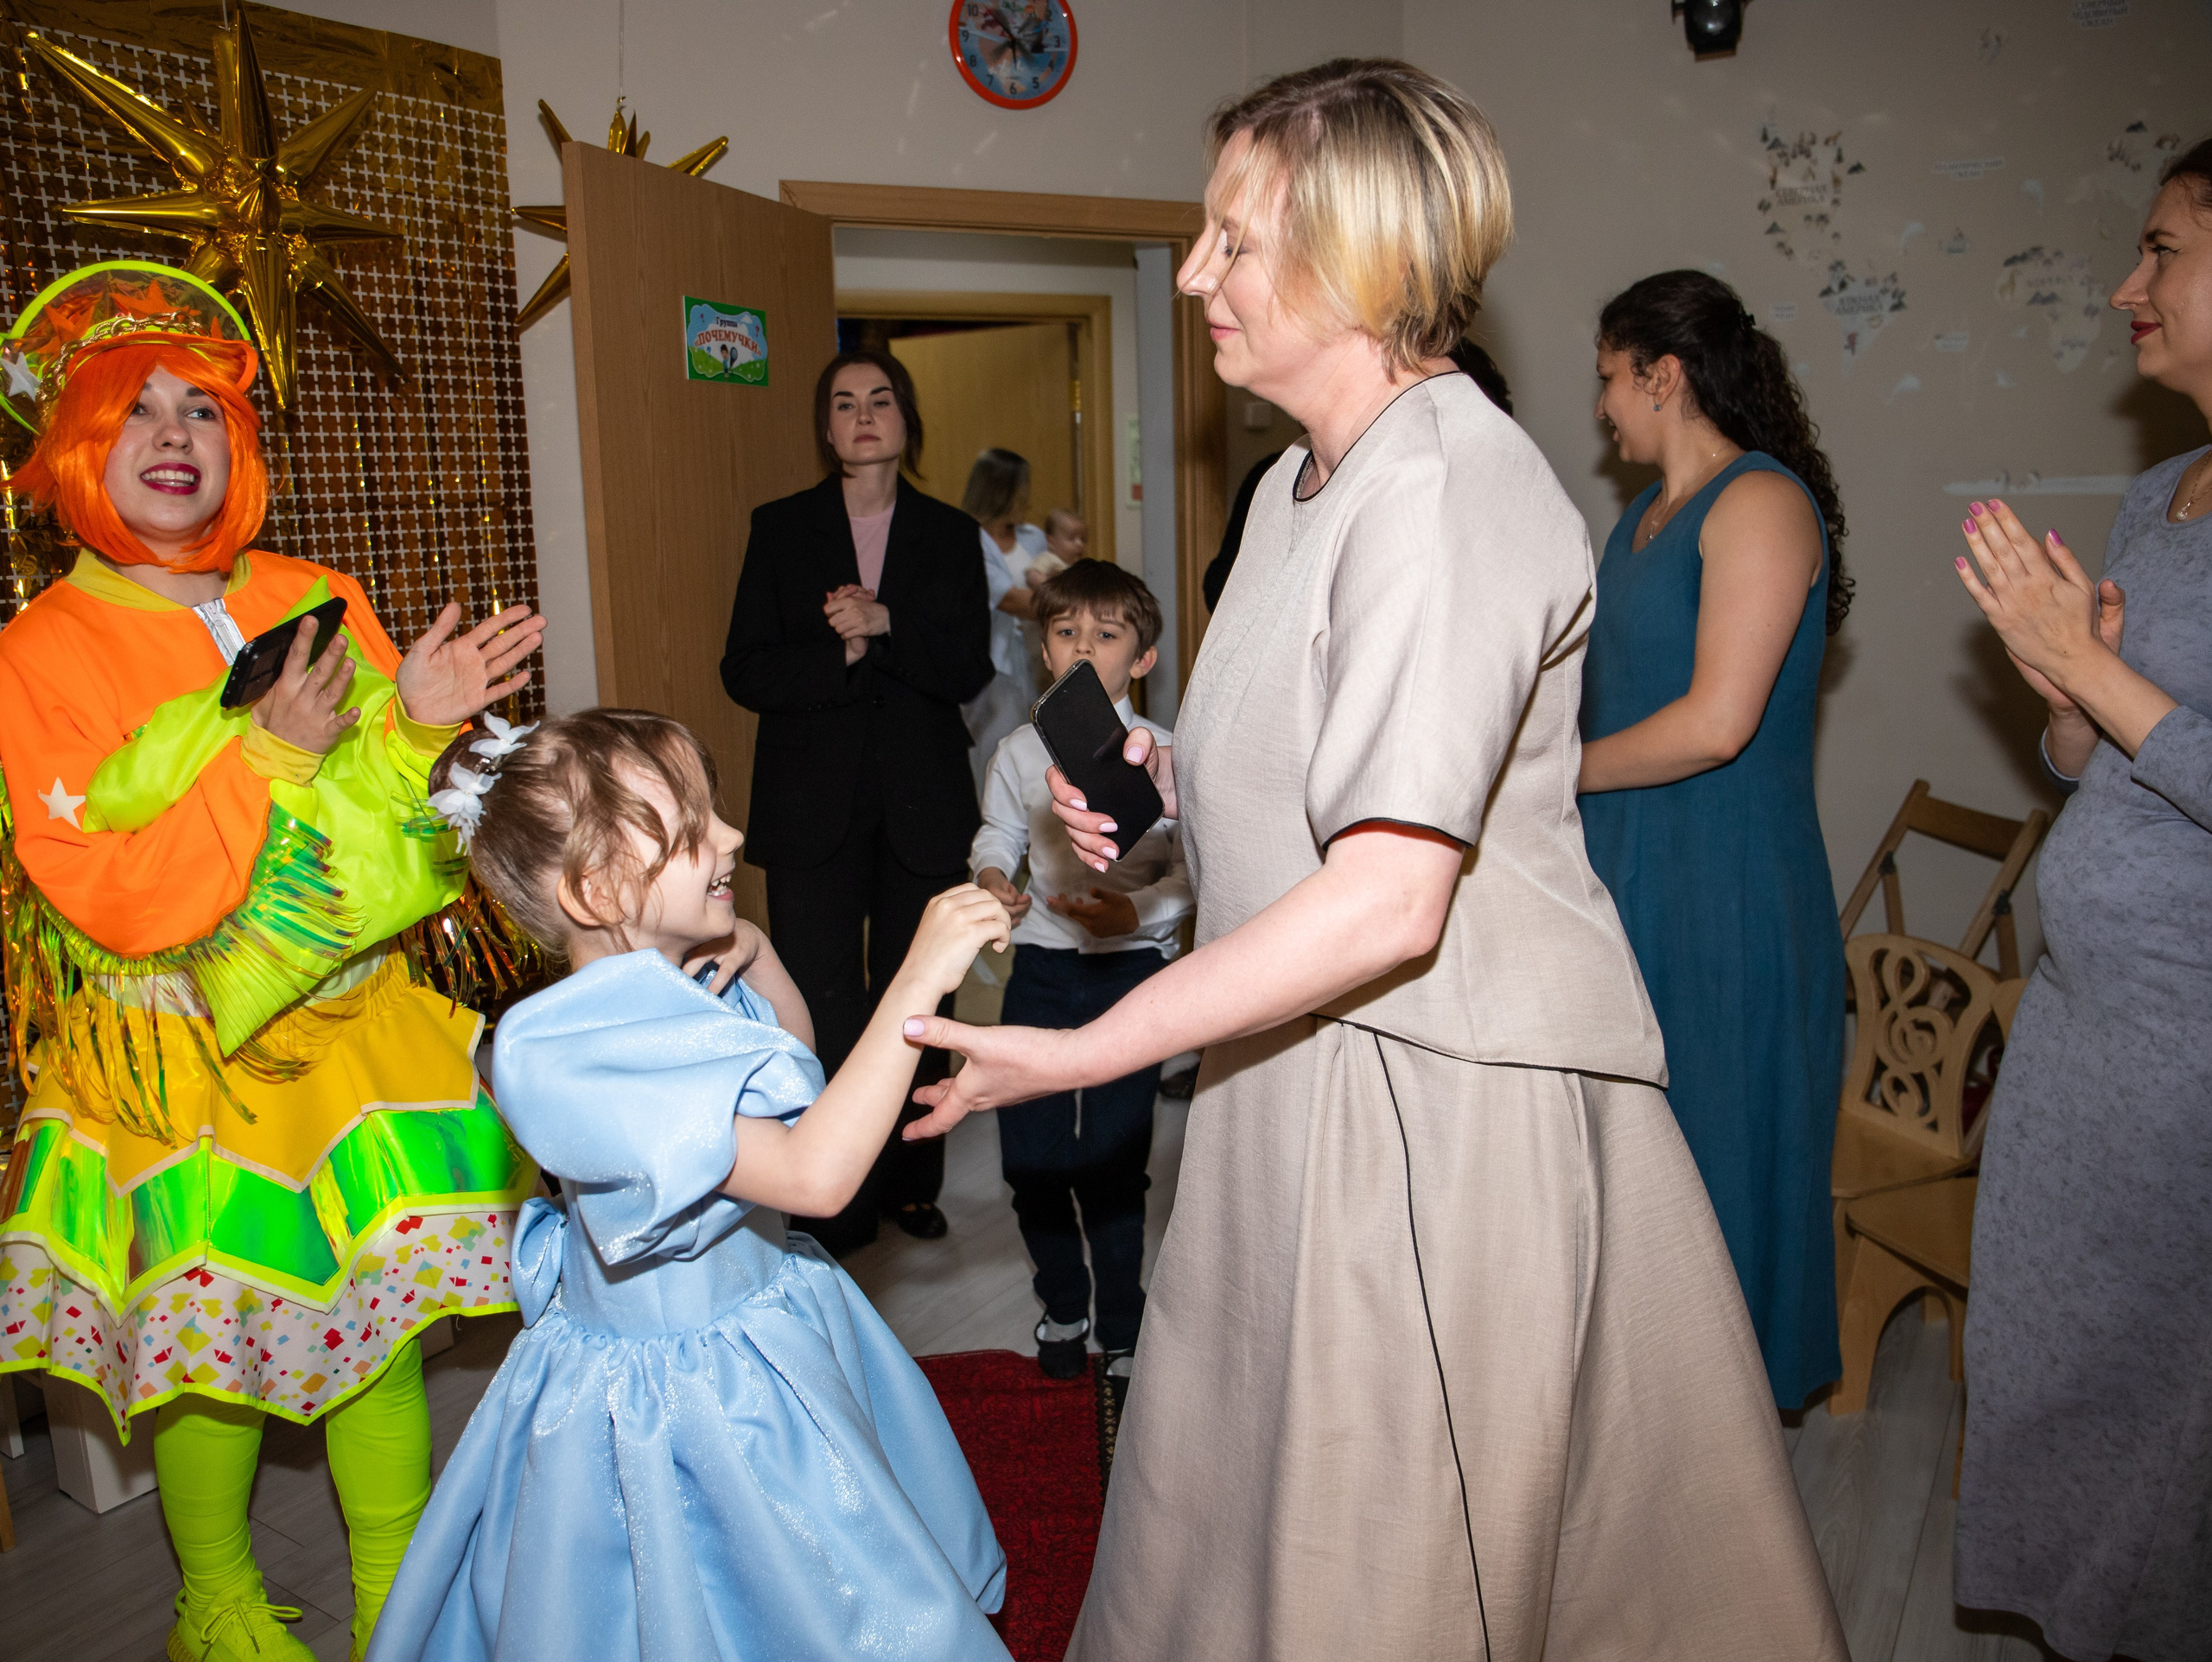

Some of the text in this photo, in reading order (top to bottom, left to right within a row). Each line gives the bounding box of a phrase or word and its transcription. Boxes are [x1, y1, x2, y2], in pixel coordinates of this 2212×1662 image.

[968, 4, 979, 17] 10
[962, 29, 969, 42] 9
[1053, 35, 1061, 48] 3
[969, 54, 977, 67] 8
[987, 73, 994, 86] 7
[1033, 76, 1040, 89] 5
[1009, 82, 1017, 95] 6
[715, 316, 738, 327] Группа
